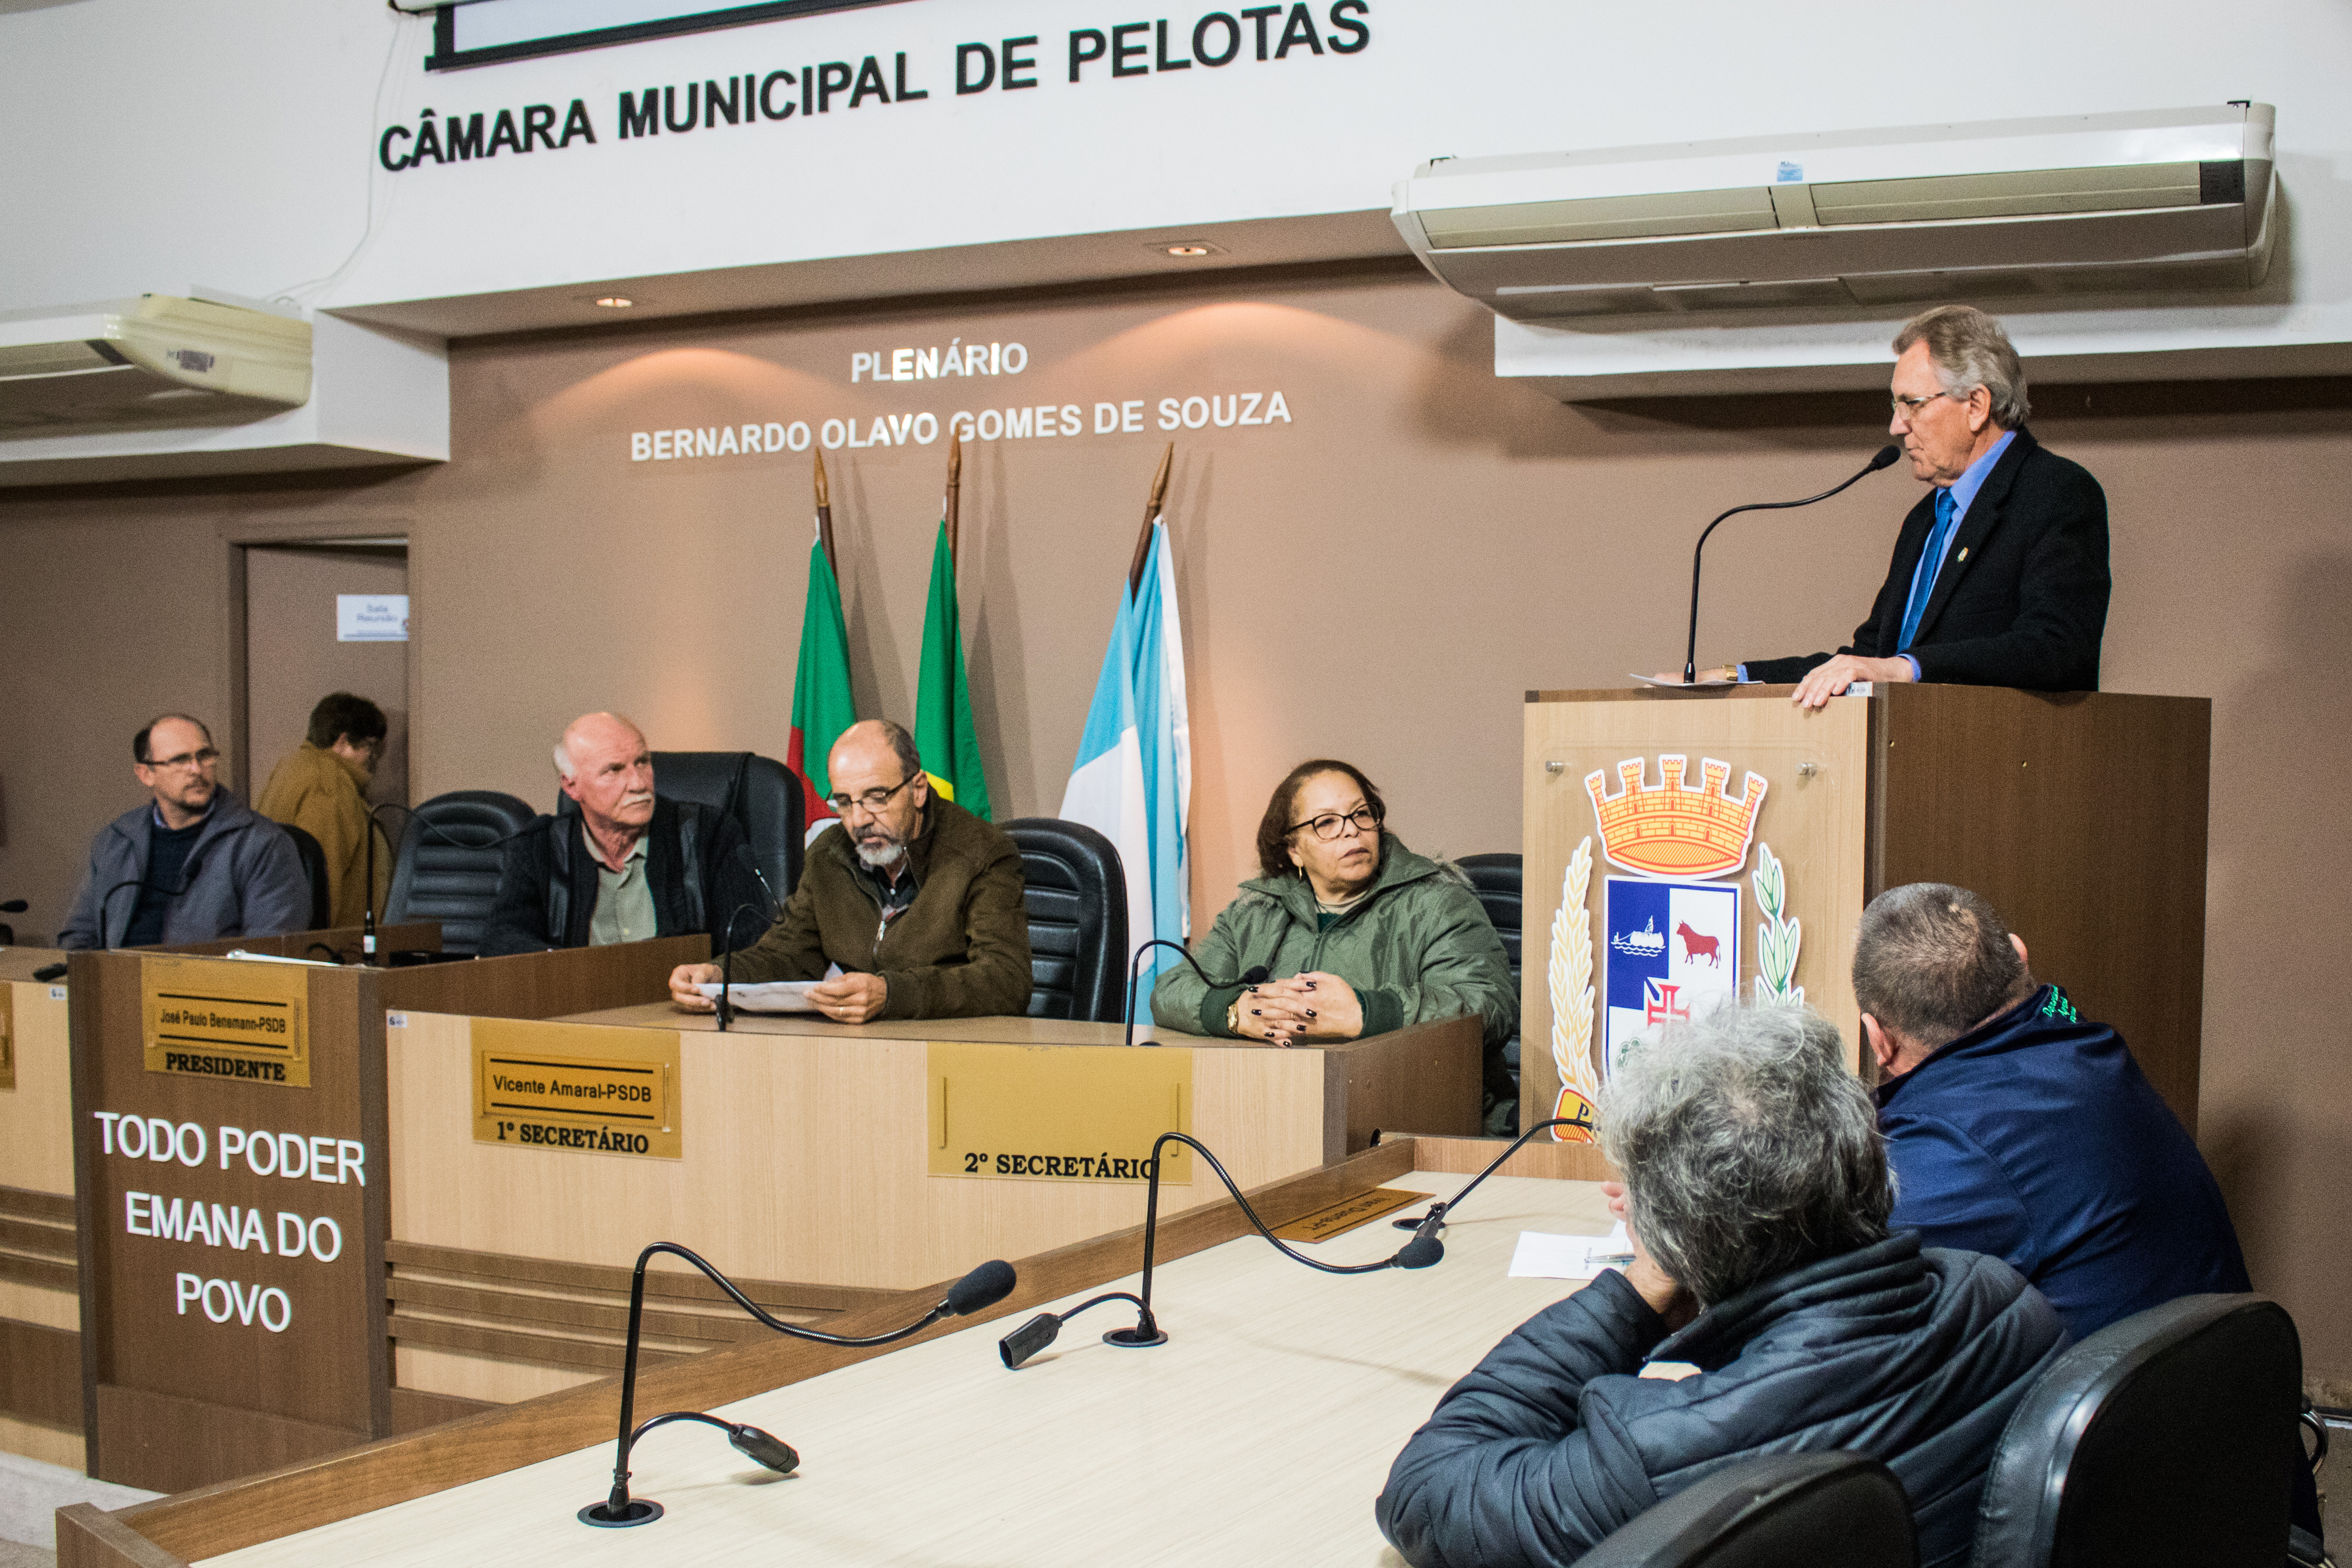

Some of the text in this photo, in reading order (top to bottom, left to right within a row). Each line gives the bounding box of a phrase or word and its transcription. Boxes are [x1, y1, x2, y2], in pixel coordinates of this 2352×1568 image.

[379, 0, 1370, 171] CÂMARA MUNICIPAL DE PELOTAS
[851, 338, 1028, 383] PLENÁRIO
[631, 391, 1292, 461] BERNARDO OLAVO GOMES DE SOUZA
[161, 1009, 181, 1025] José
[183, 1010, 207, 1027] Paulo
[165, 1051, 286, 1081] PRESIDENTE
[493, 1074, 651, 1102] Vicente Amaral-PSDB
[94, 1111, 366, 1187] TODO PODER
[520, 1125, 650, 1154] SECRETÁRIO
[125, 1191, 343, 1262] EMANA DO
[176, 1272, 292, 1332] POVO
